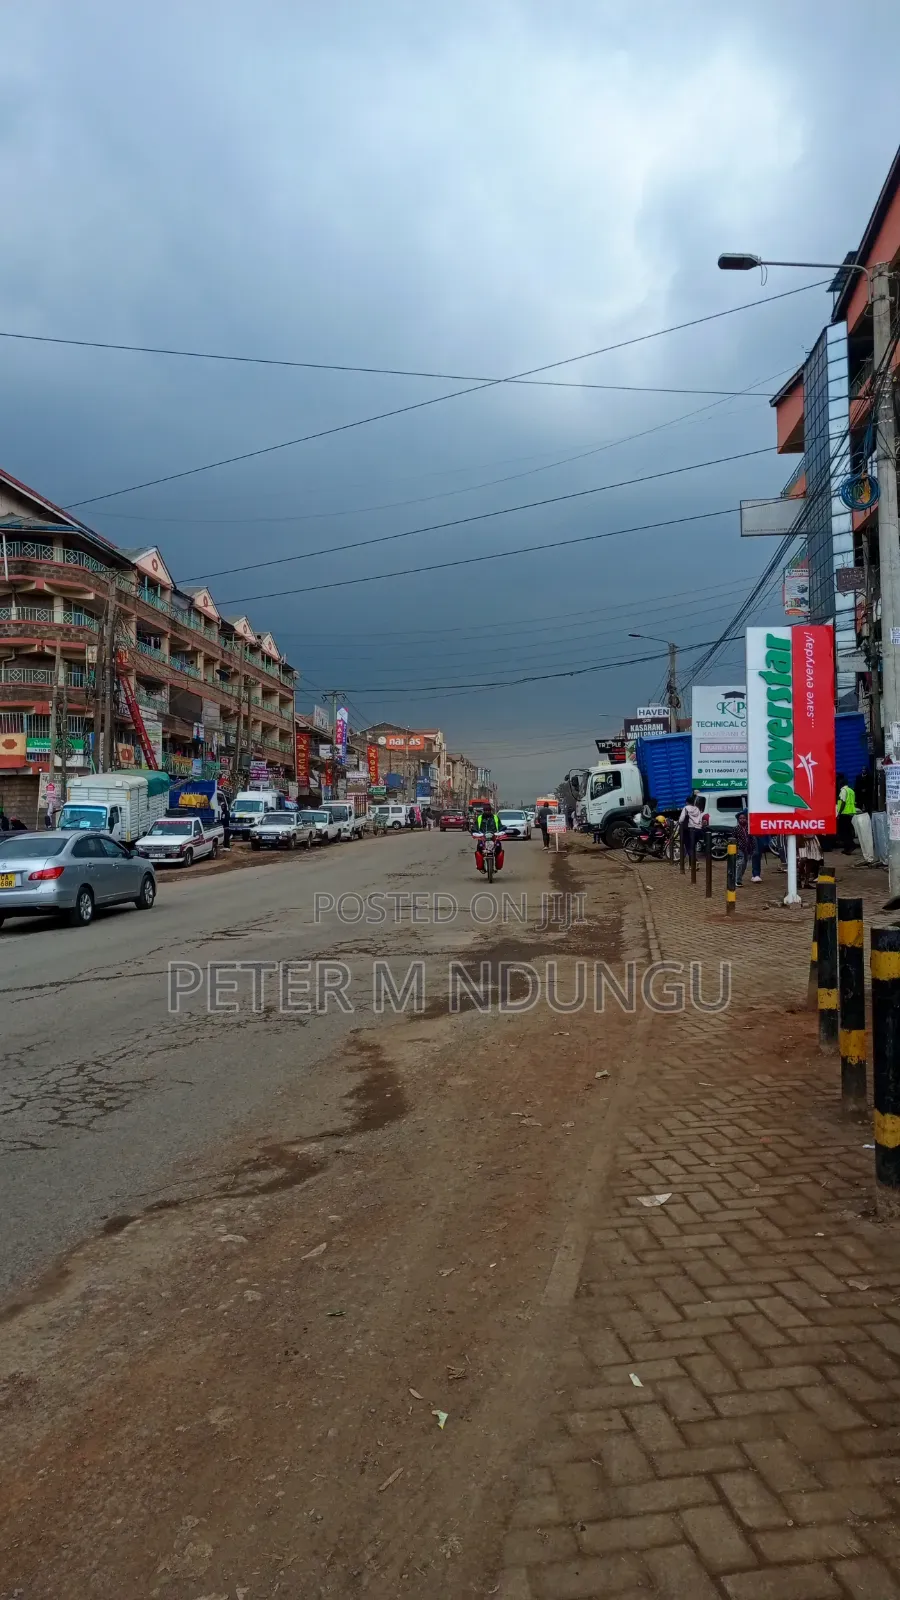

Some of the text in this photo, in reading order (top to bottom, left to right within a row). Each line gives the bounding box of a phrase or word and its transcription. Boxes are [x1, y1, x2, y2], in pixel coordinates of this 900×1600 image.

[804, 632, 815, 729] ...save everyday!
[638, 708, 670, 716] HAVEN
[716, 699, 747, 719] KiP
[696, 720, 739, 728] TECHNICAL
[758, 633, 811, 811] powerstar
[630, 723, 664, 732] KASARANI
[389, 737, 421, 746] naias
[760, 819, 826, 830] ENTRANCE
